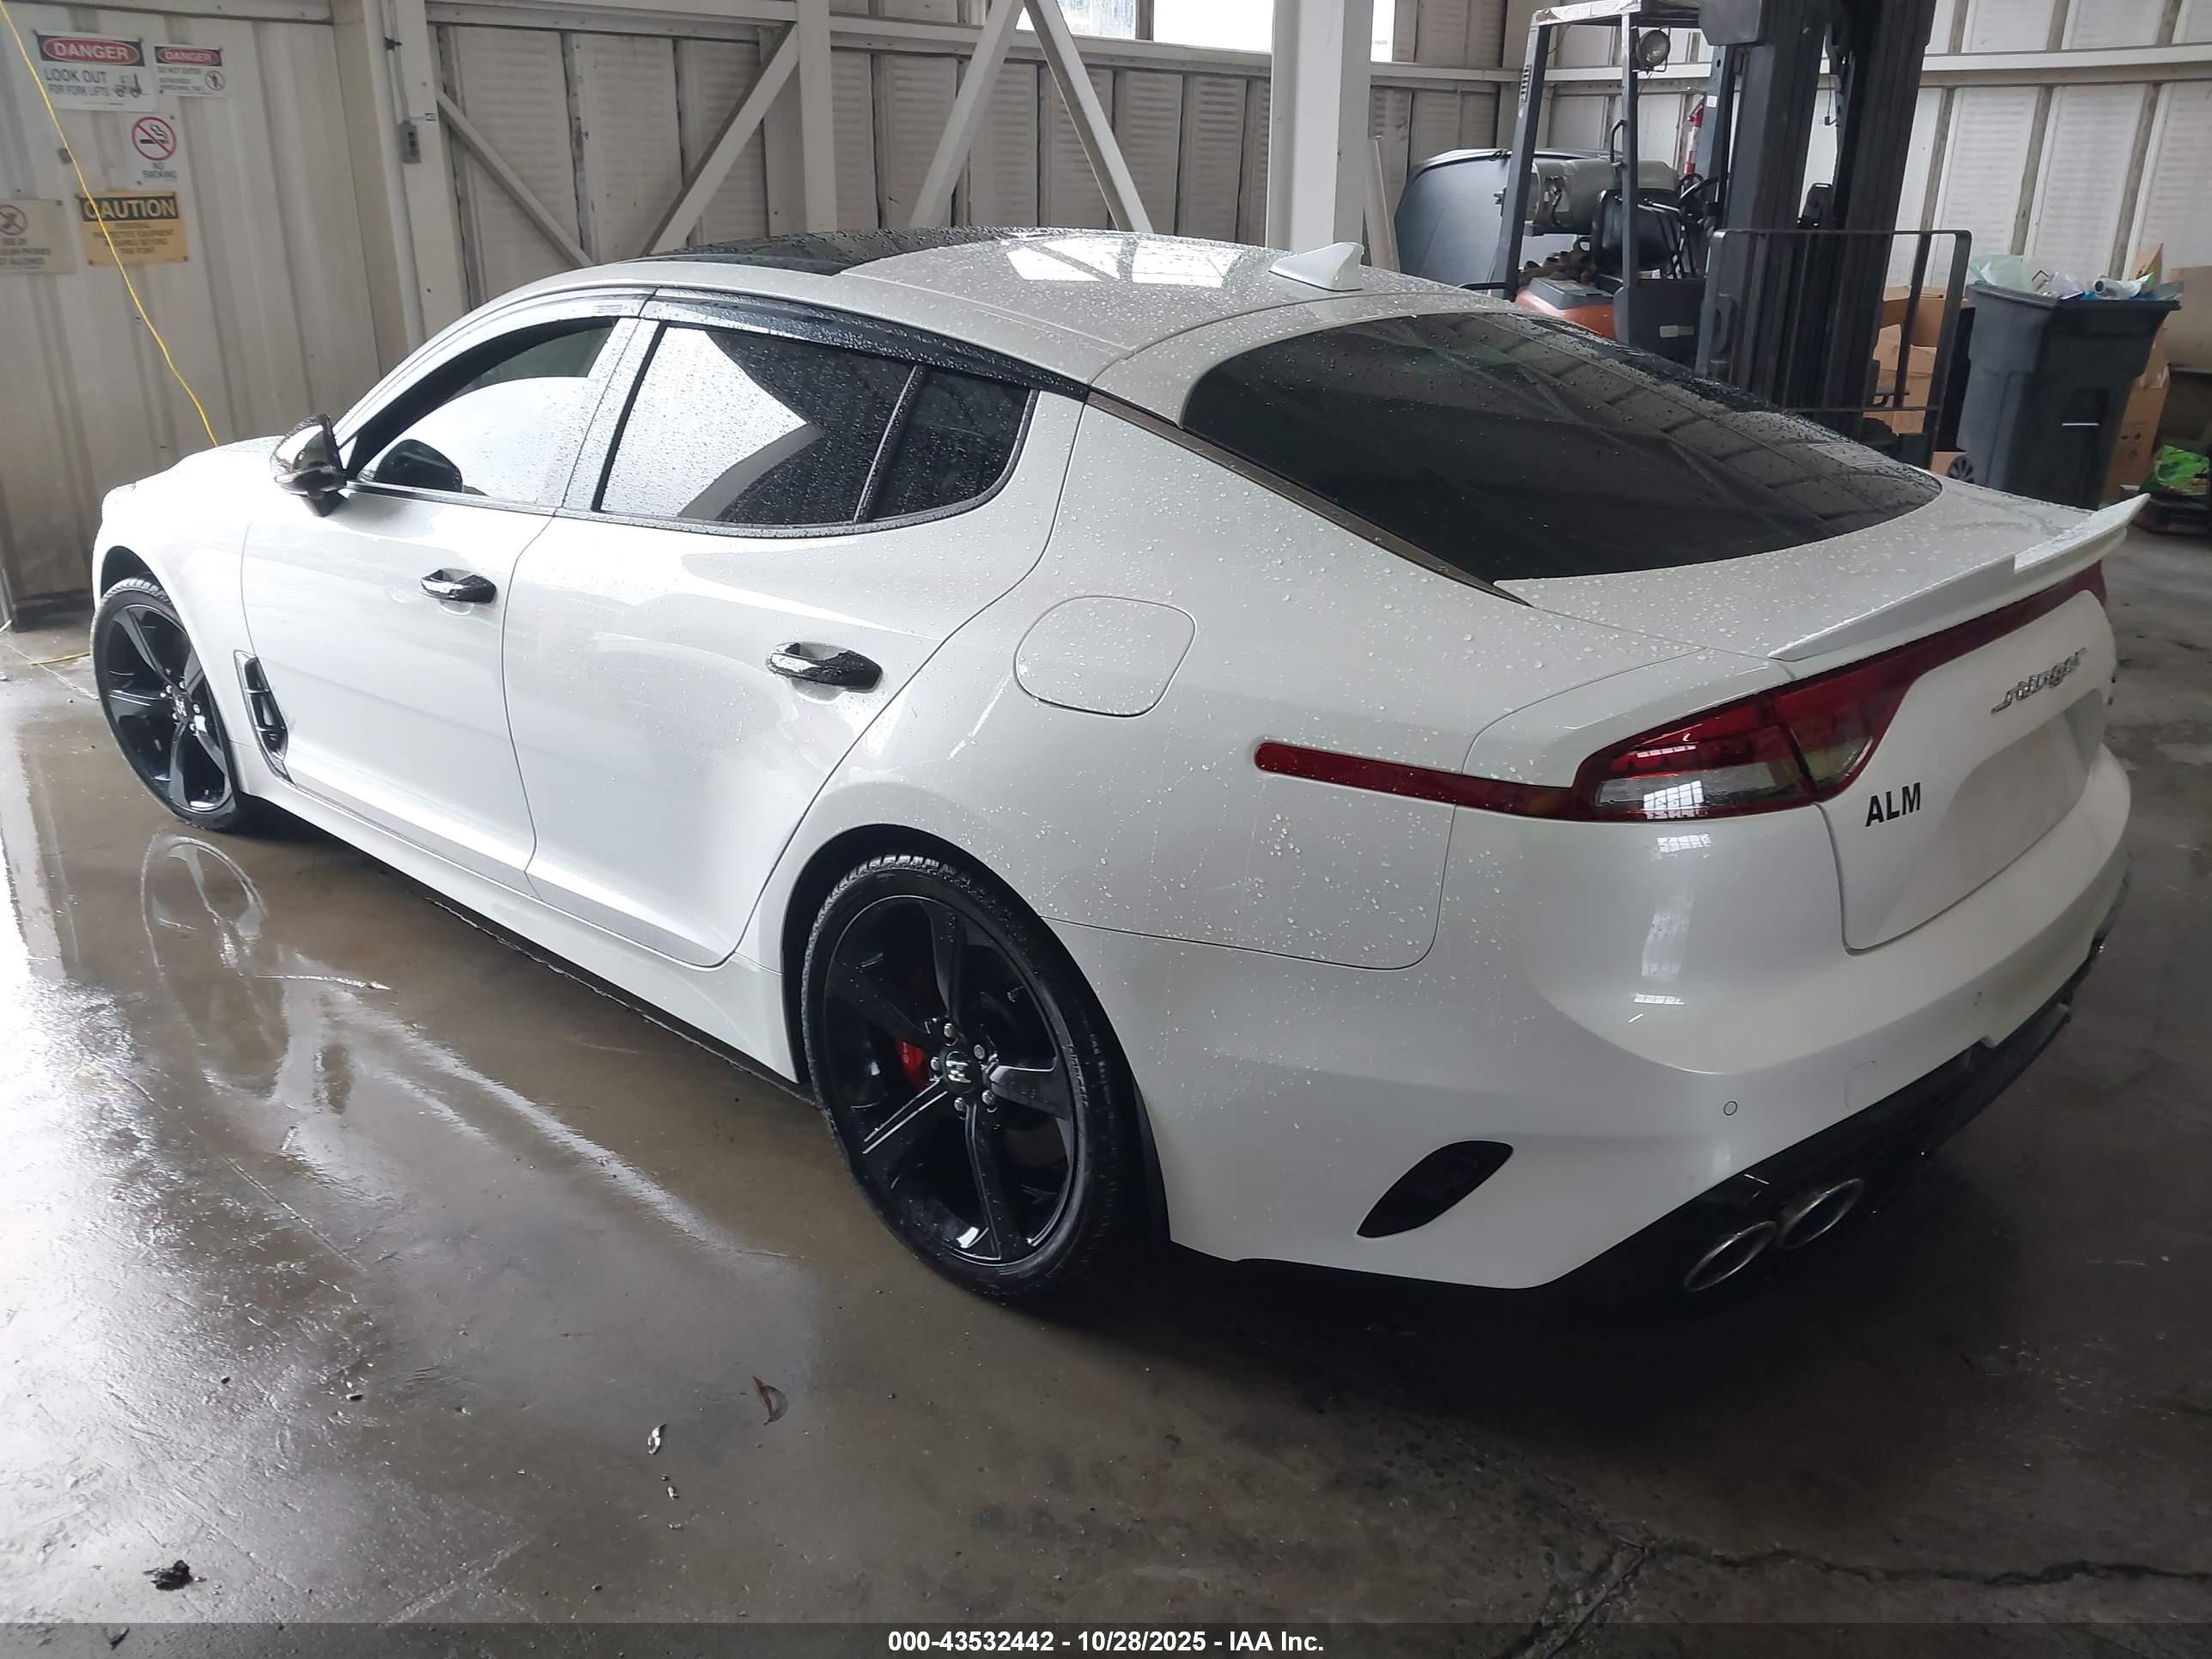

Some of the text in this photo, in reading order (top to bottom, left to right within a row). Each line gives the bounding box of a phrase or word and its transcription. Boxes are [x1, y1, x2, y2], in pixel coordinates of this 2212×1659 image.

[54, 42, 130, 60] DANGER
[164, 51, 212, 63] DANGER
[44, 68, 106, 84] LOOK OUT
[83, 198, 177, 219] CAUTION
[1864, 782, 1921, 827] ALM
